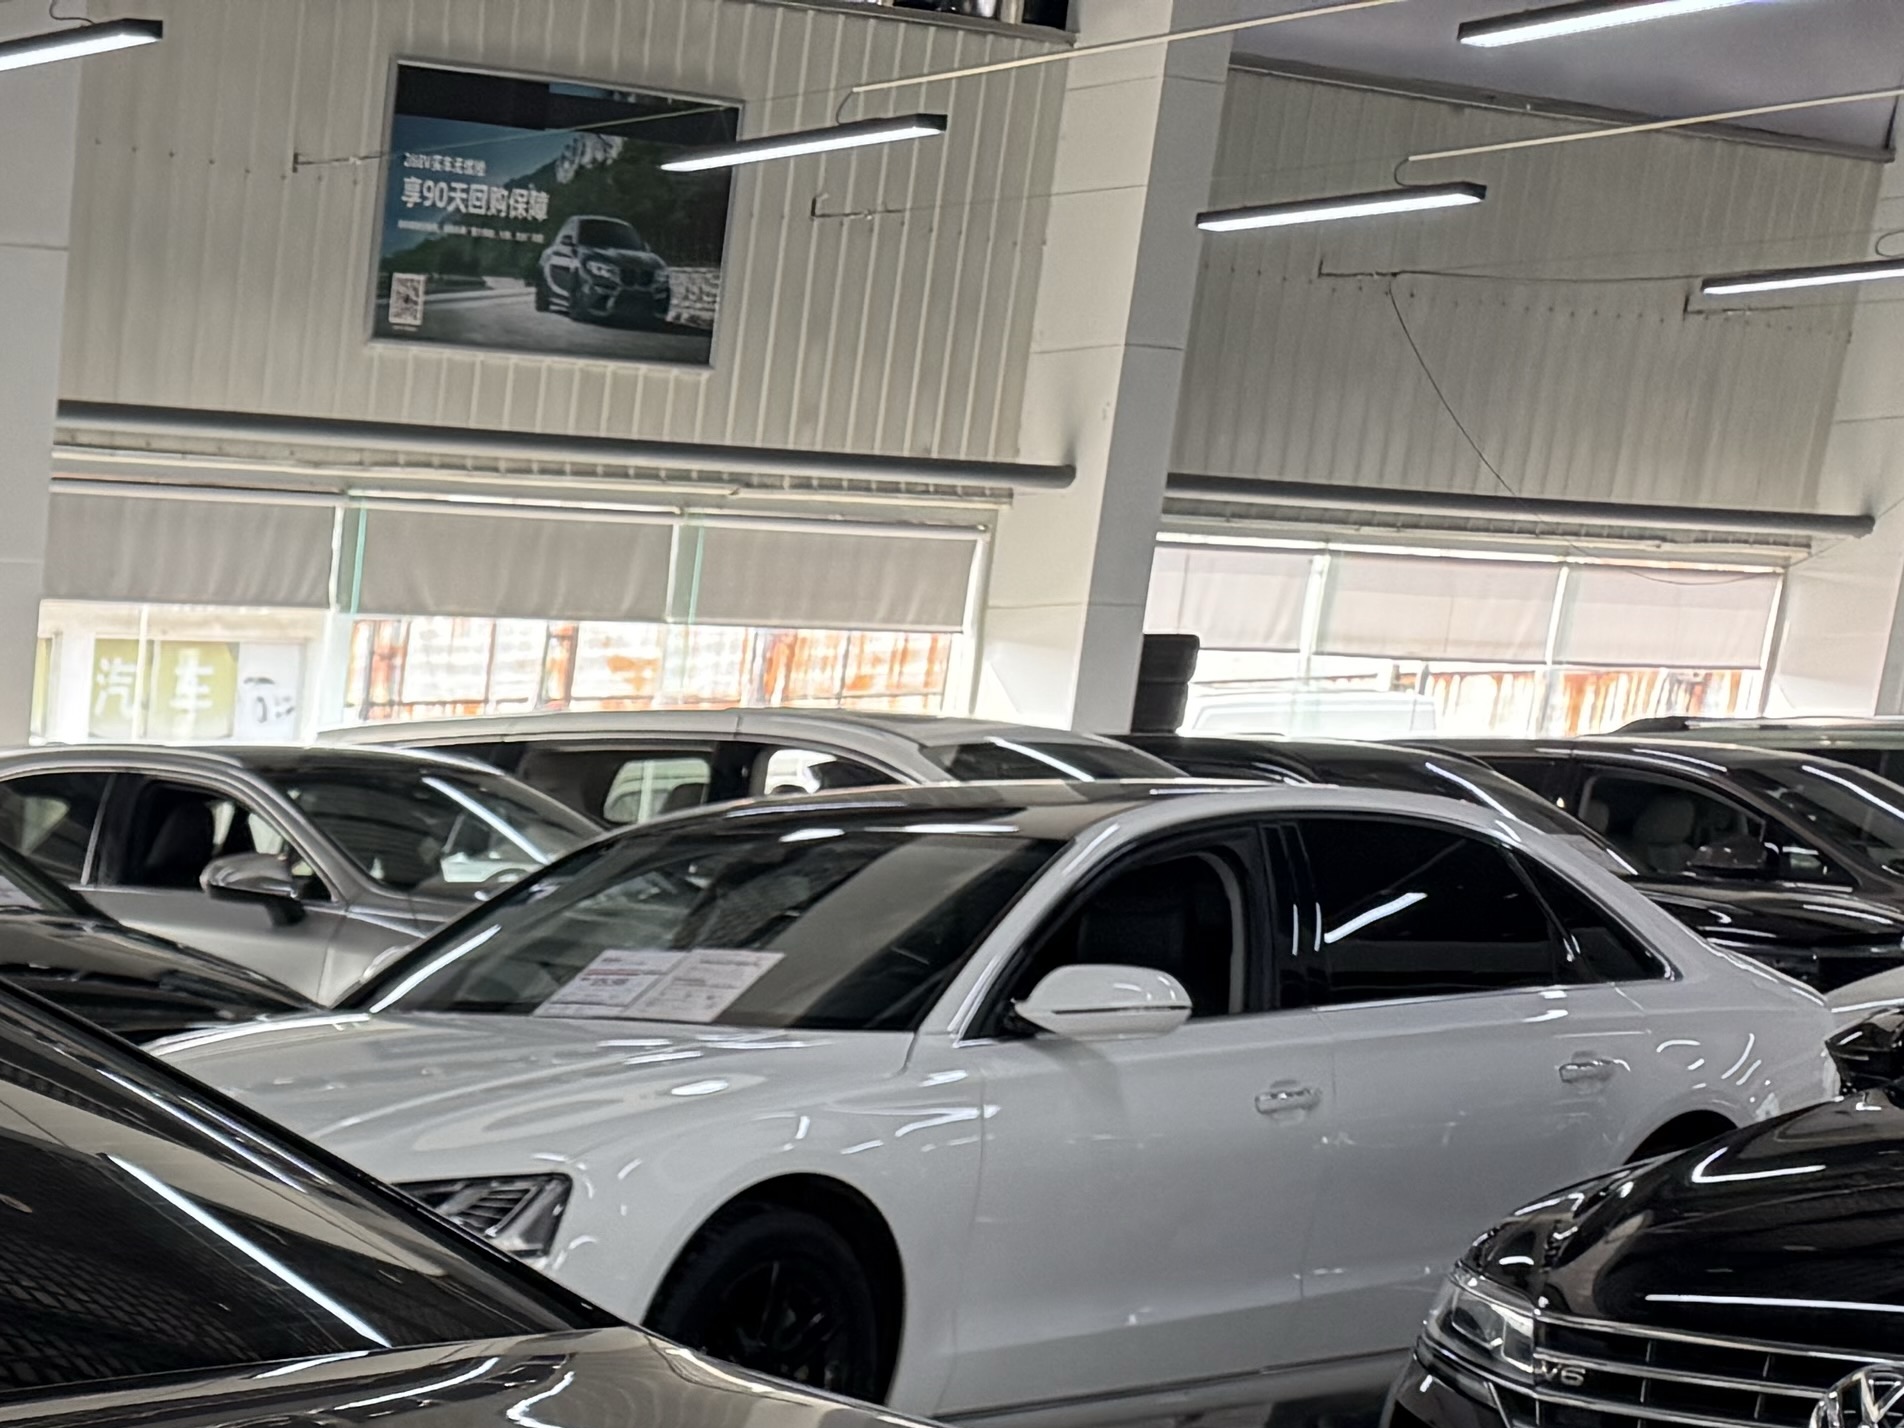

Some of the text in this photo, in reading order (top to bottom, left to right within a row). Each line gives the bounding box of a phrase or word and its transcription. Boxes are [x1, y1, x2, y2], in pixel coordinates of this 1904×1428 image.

[401, 176, 550, 223] 享90天回购保障
[1540, 1359, 1587, 1387] V6
